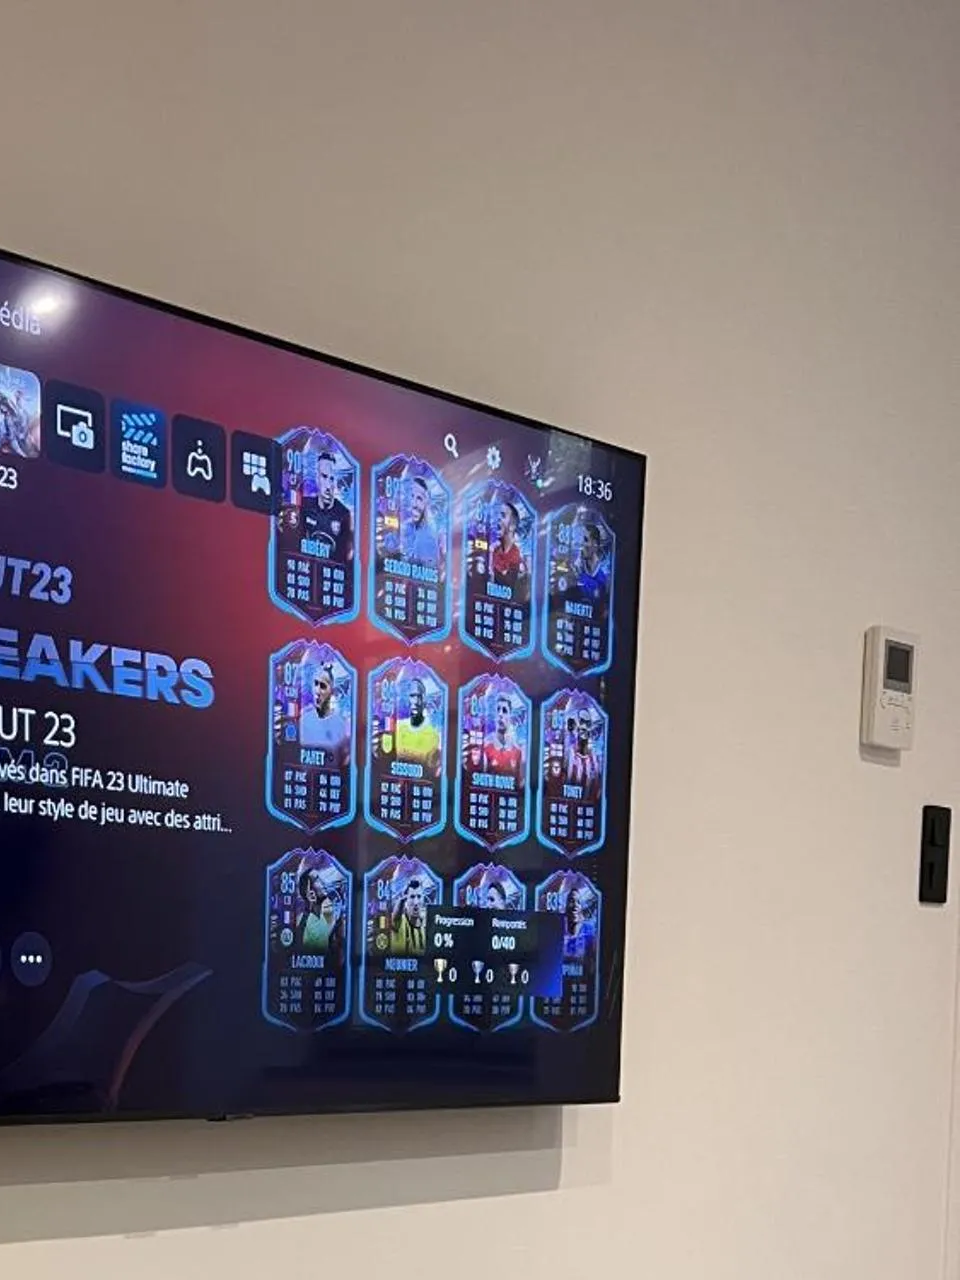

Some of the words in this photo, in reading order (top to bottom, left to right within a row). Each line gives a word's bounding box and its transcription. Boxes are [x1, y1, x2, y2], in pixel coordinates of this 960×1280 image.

[578, 474, 613, 502] 18:36
[43, 711, 77, 748] 23
[29, 762, 68, 785] dans
[72, 767, 104, 789] FIFA
[106, 771, 125, 792] 23
[128, 774, 190, 798] Ultimate
[3, 792, 35, 815] leur
[38, 798, 75, 821] style
[78, 800, 97, 820] de
[100, 803, 125, 825] jeu
[128, 811, 162, 827] avec
[164, 809, 190, 829] des
[280, 871, 295, 894] 85
[434, 914, 474, 927] Progression
[491, 934, 516, 950] 0/40
